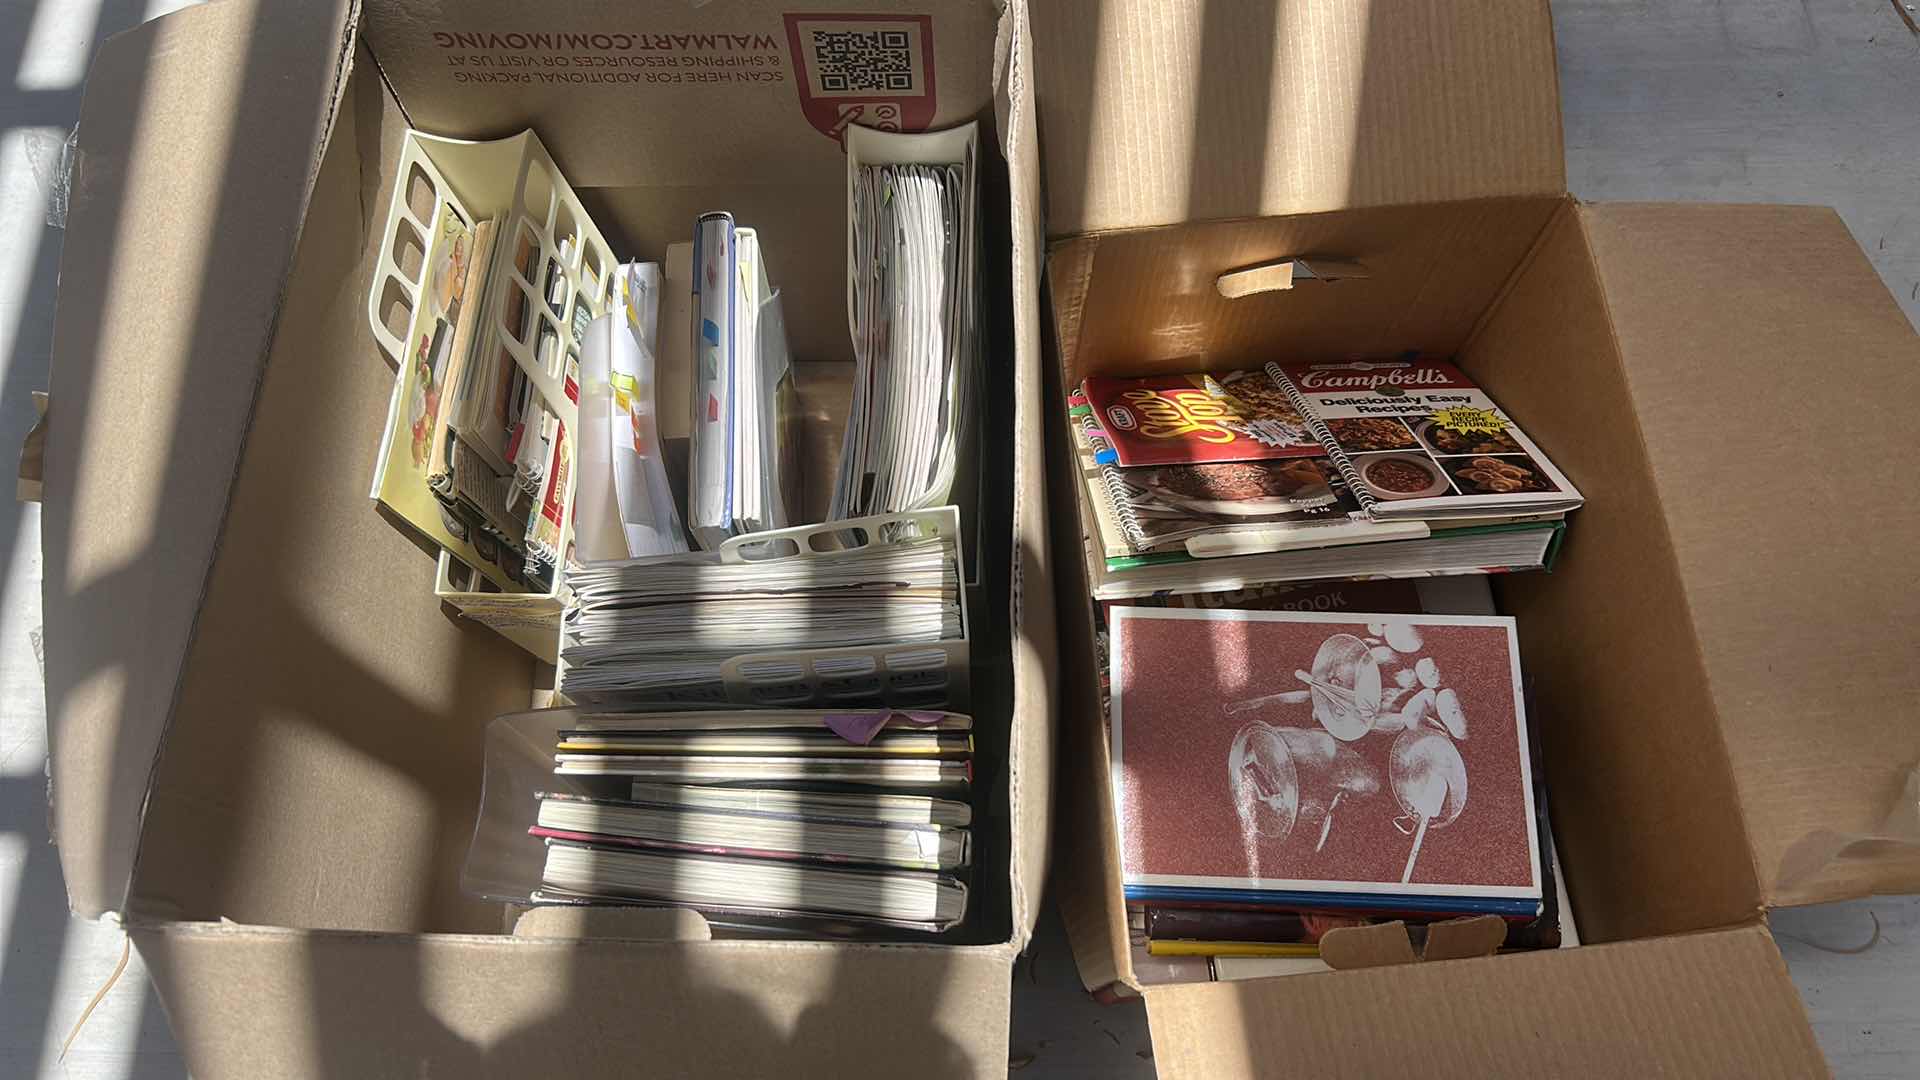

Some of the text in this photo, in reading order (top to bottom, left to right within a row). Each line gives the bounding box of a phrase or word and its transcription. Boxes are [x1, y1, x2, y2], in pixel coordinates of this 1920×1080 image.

[433, 32, 778, 50] WALMART.COM/MOVING
[447, 55, 780, 67] & SHIPPING RESOURCES OR VISIT US AT
[455, 71, 784, 84] SCAN HERE FOR ADDITIONAL PACKING
[1301, 368, 1454, 389] Campbell's
[1320, 395, 1472, 406] Deliciously Easy
[1356, 404, 1433, 414] Recipes
